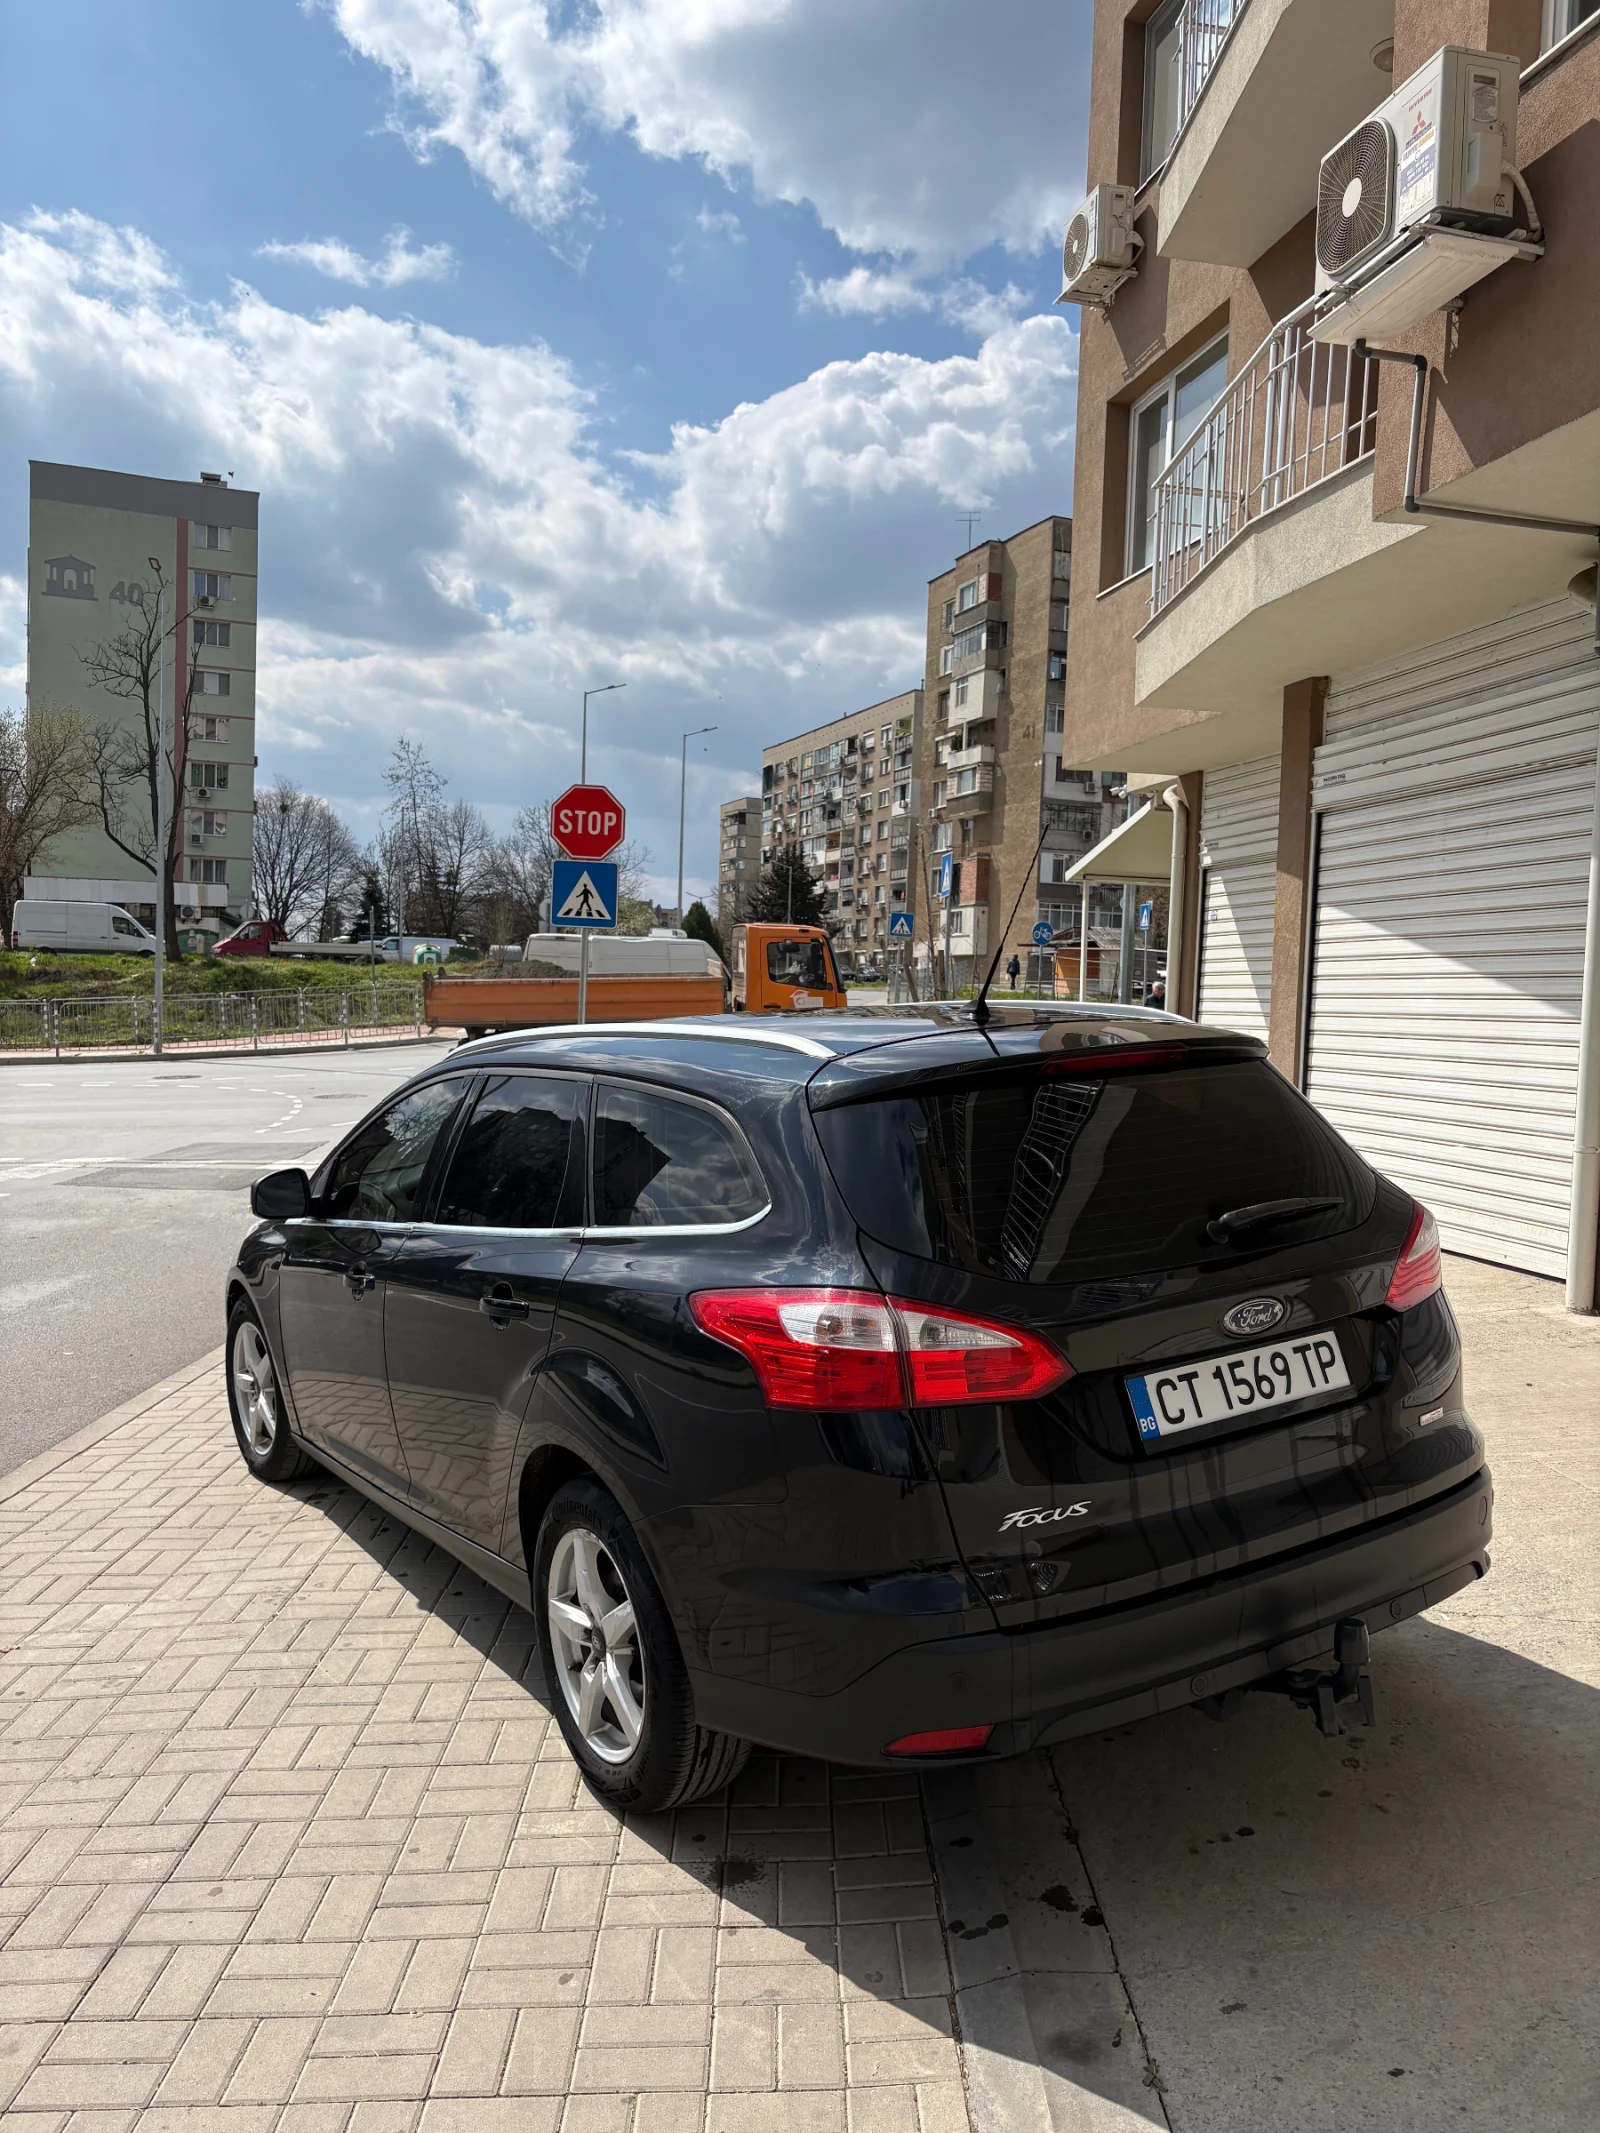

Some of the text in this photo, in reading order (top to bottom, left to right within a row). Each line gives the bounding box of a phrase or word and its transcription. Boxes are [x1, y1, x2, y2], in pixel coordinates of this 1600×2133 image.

[109, 581, 143, 606] 40
[559, 809, 617, 836] STOP
[1240, 1305, 1272, 1328] Ford
[1156, 1340, 1335, 1425] CT 1569 TP
[1139, 1416, 1157, 1433] BG
